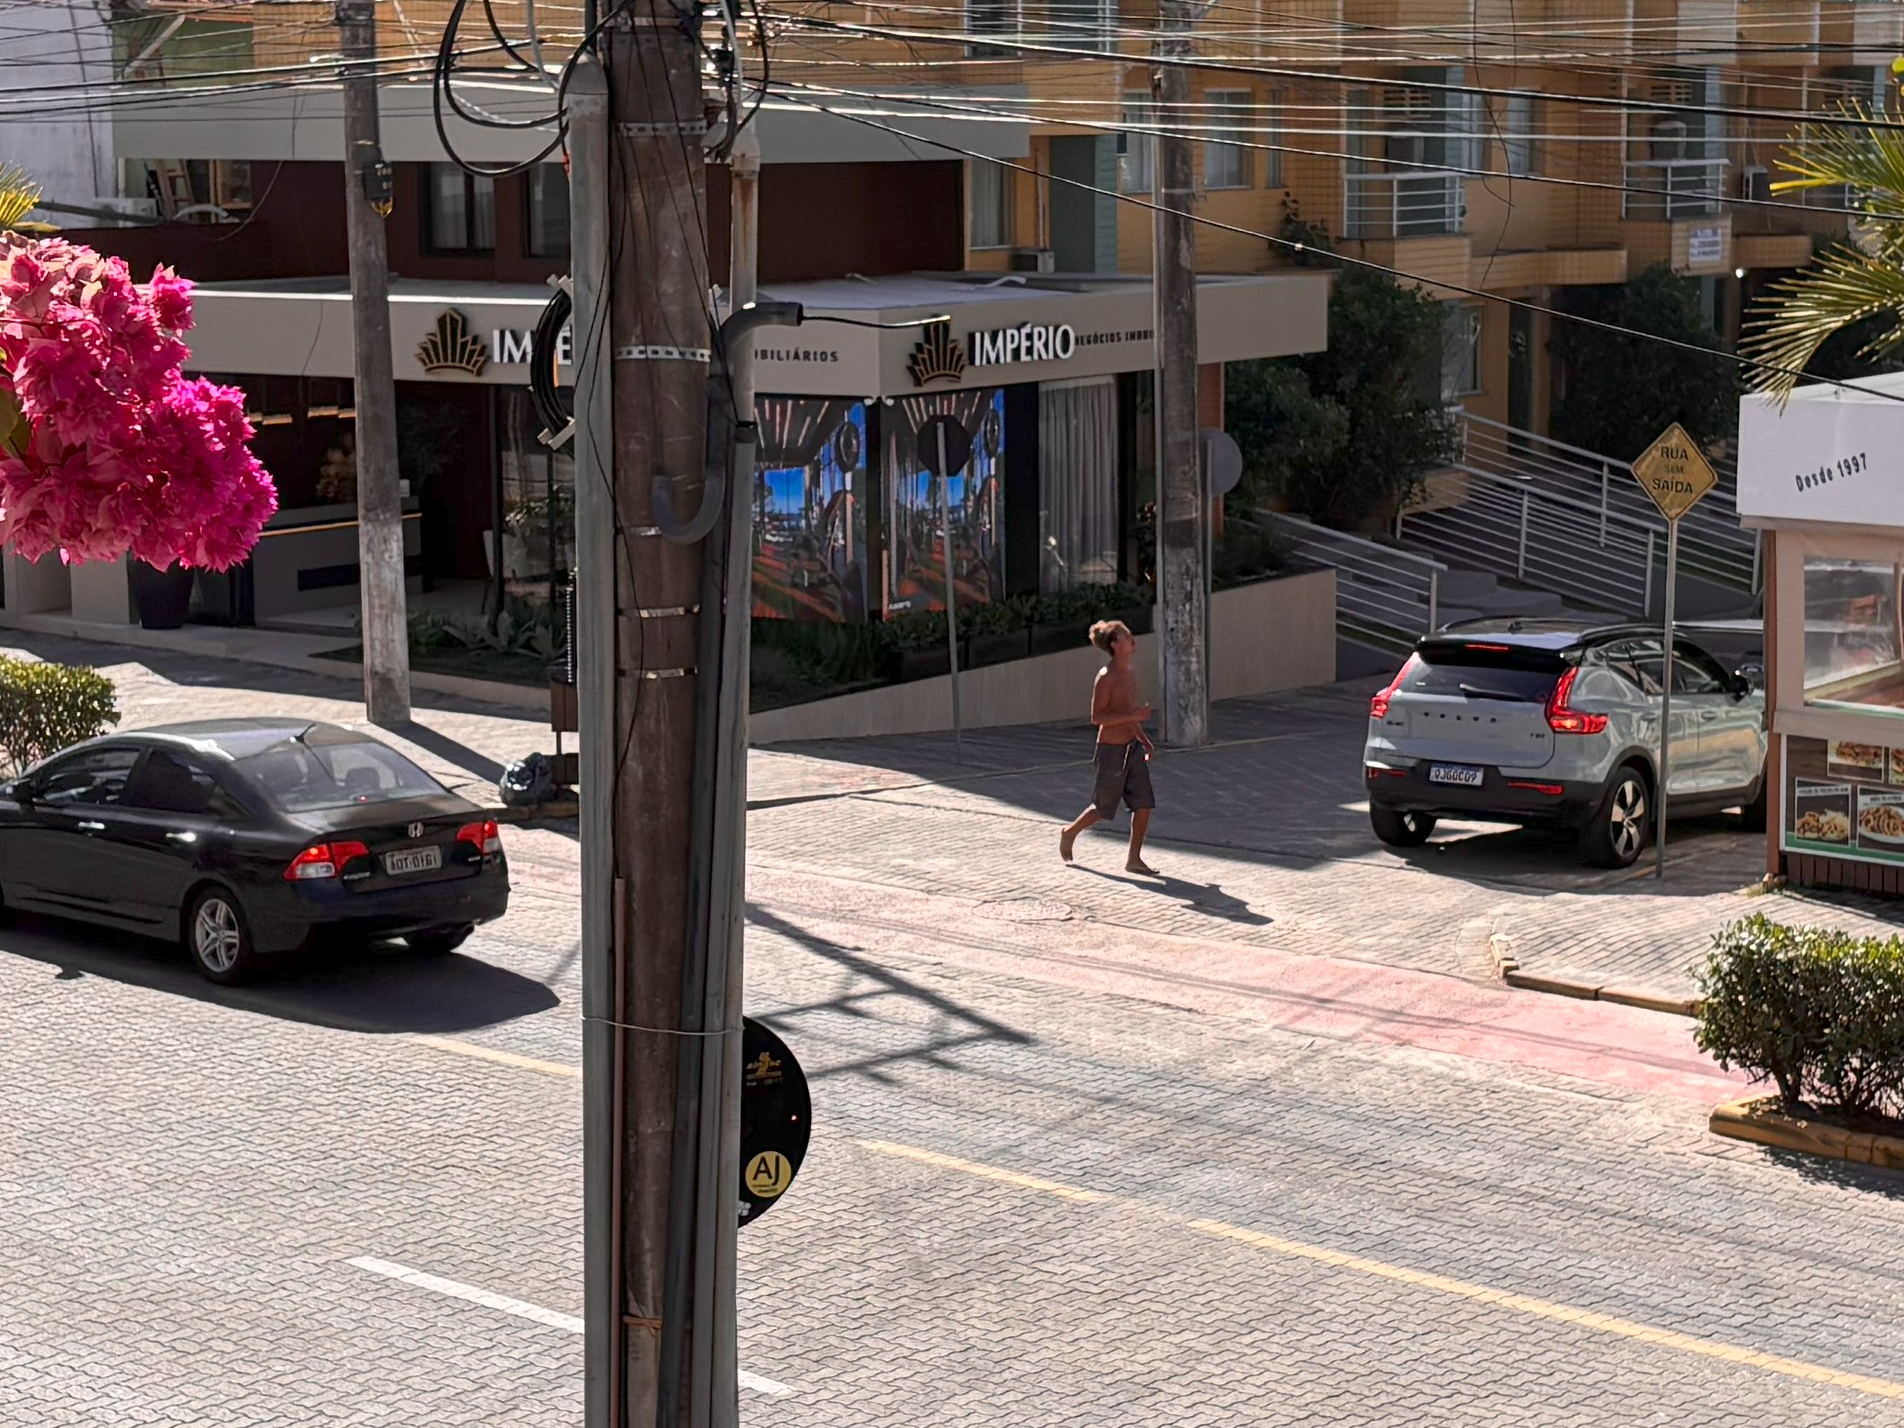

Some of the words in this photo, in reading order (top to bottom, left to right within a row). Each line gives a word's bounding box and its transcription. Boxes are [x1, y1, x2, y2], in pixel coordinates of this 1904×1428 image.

[974, 323, 1076, 366] IMPÉRIO
[1075, 332, 1122, 346] NEGÓCIOS
[1660, 446, 1688, 461] RUA
[1795, 466, 1833, 492] Desde
[1837, 452, 1866, 477] 1997
[752, 1154, 781, 1186] AJ
